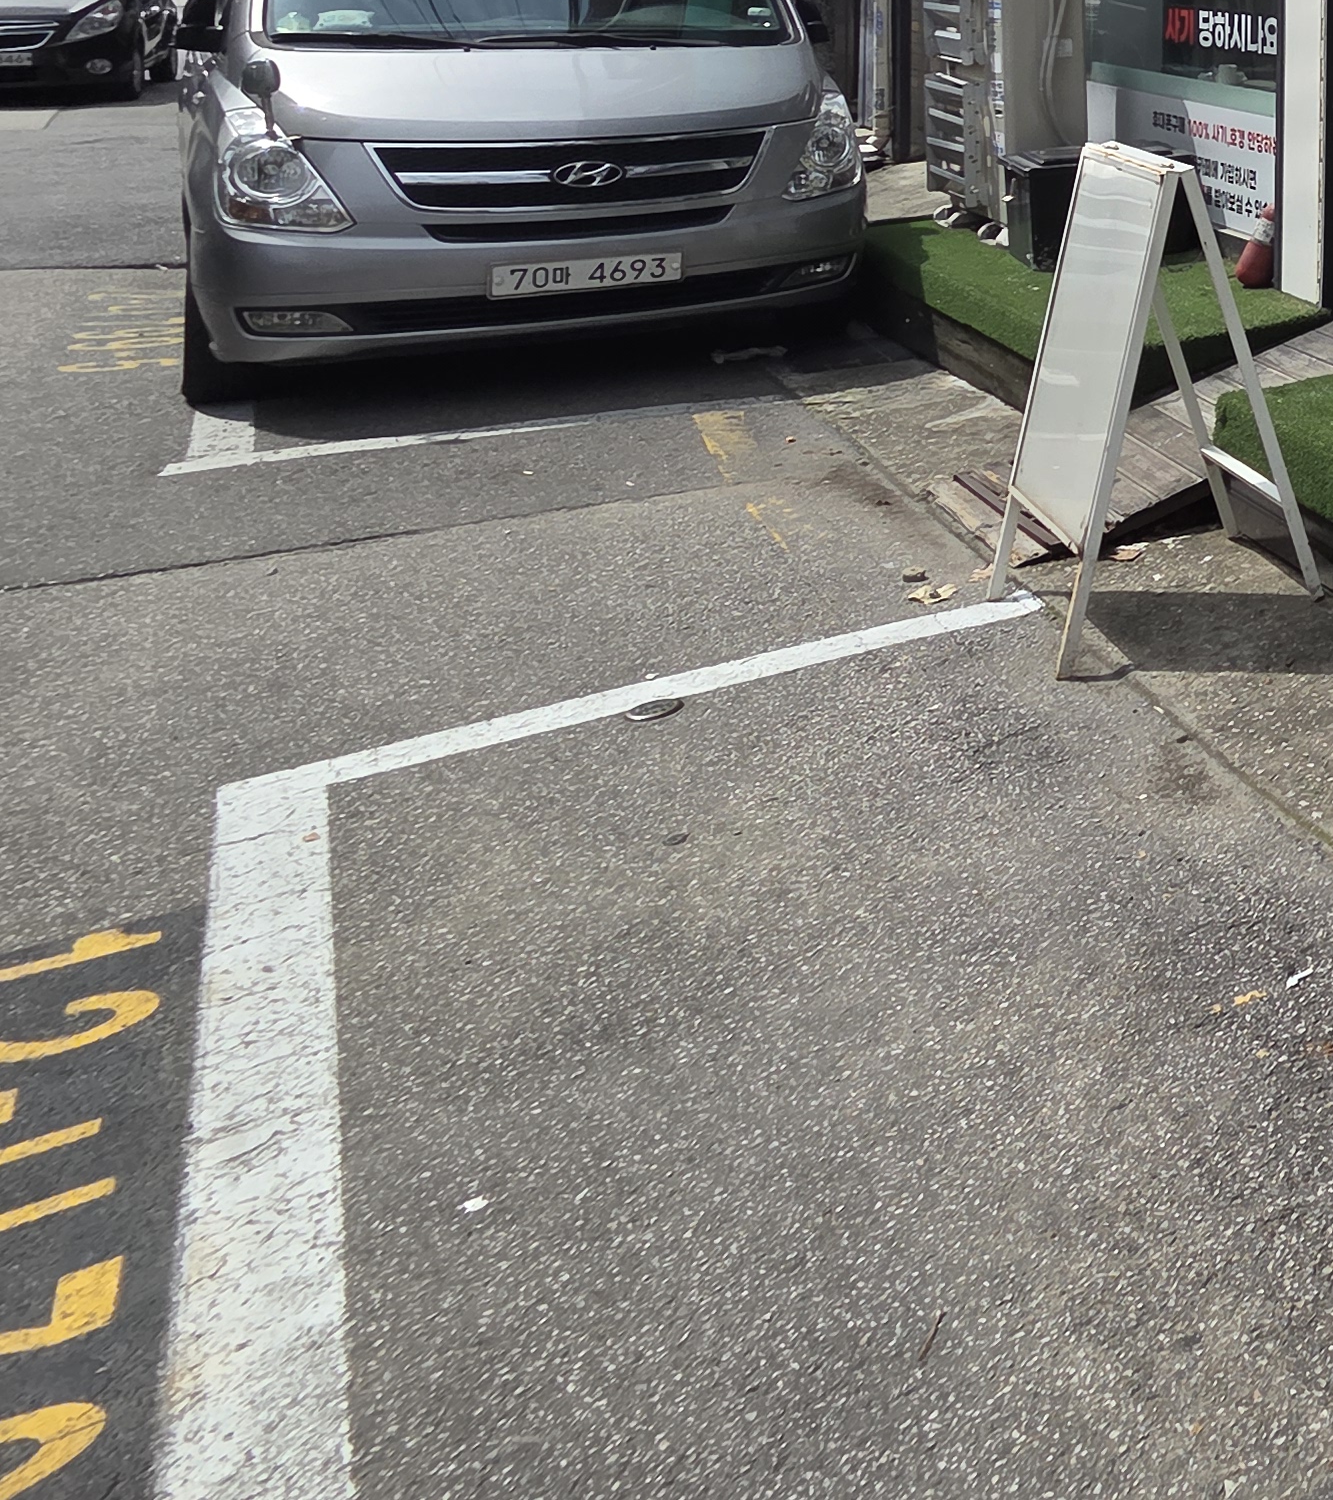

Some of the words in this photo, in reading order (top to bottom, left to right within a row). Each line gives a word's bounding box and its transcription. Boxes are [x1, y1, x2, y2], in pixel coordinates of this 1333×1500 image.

[1165, 7, 1195, 46] 사기
[1187, 118, 1210, 141] 100%
[509, 265, 572, 291] 70마
[587, 257, 667, 284] 4693
